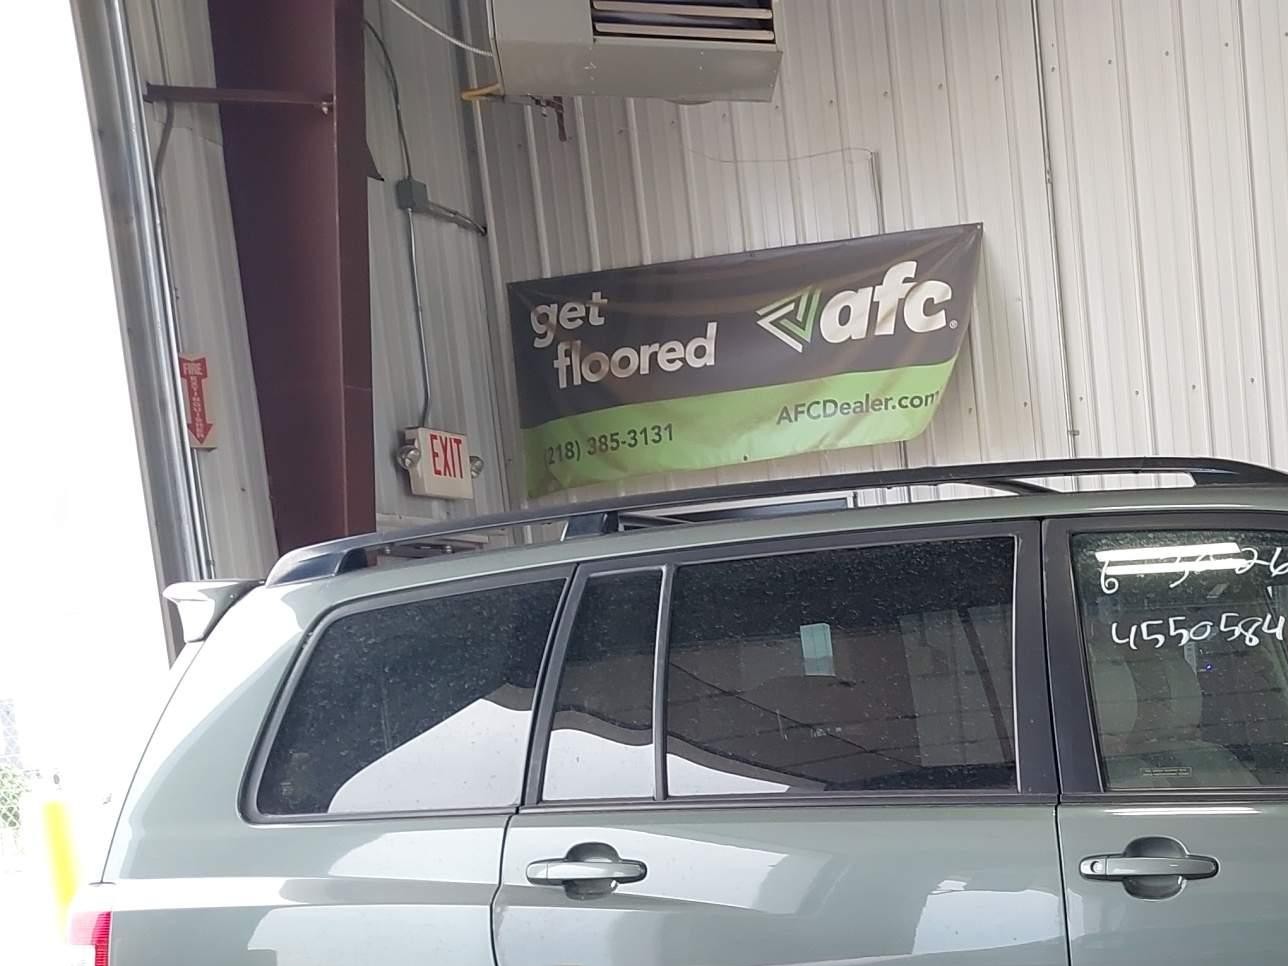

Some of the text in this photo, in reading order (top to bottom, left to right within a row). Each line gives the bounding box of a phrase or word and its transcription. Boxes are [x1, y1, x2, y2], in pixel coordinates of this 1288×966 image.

[531, 292, 607, 348] get
[554, 322, 718, 389] floored
[430, 434, 464, 479] EXIT
[587, 423, 673, 456] 385-3131
